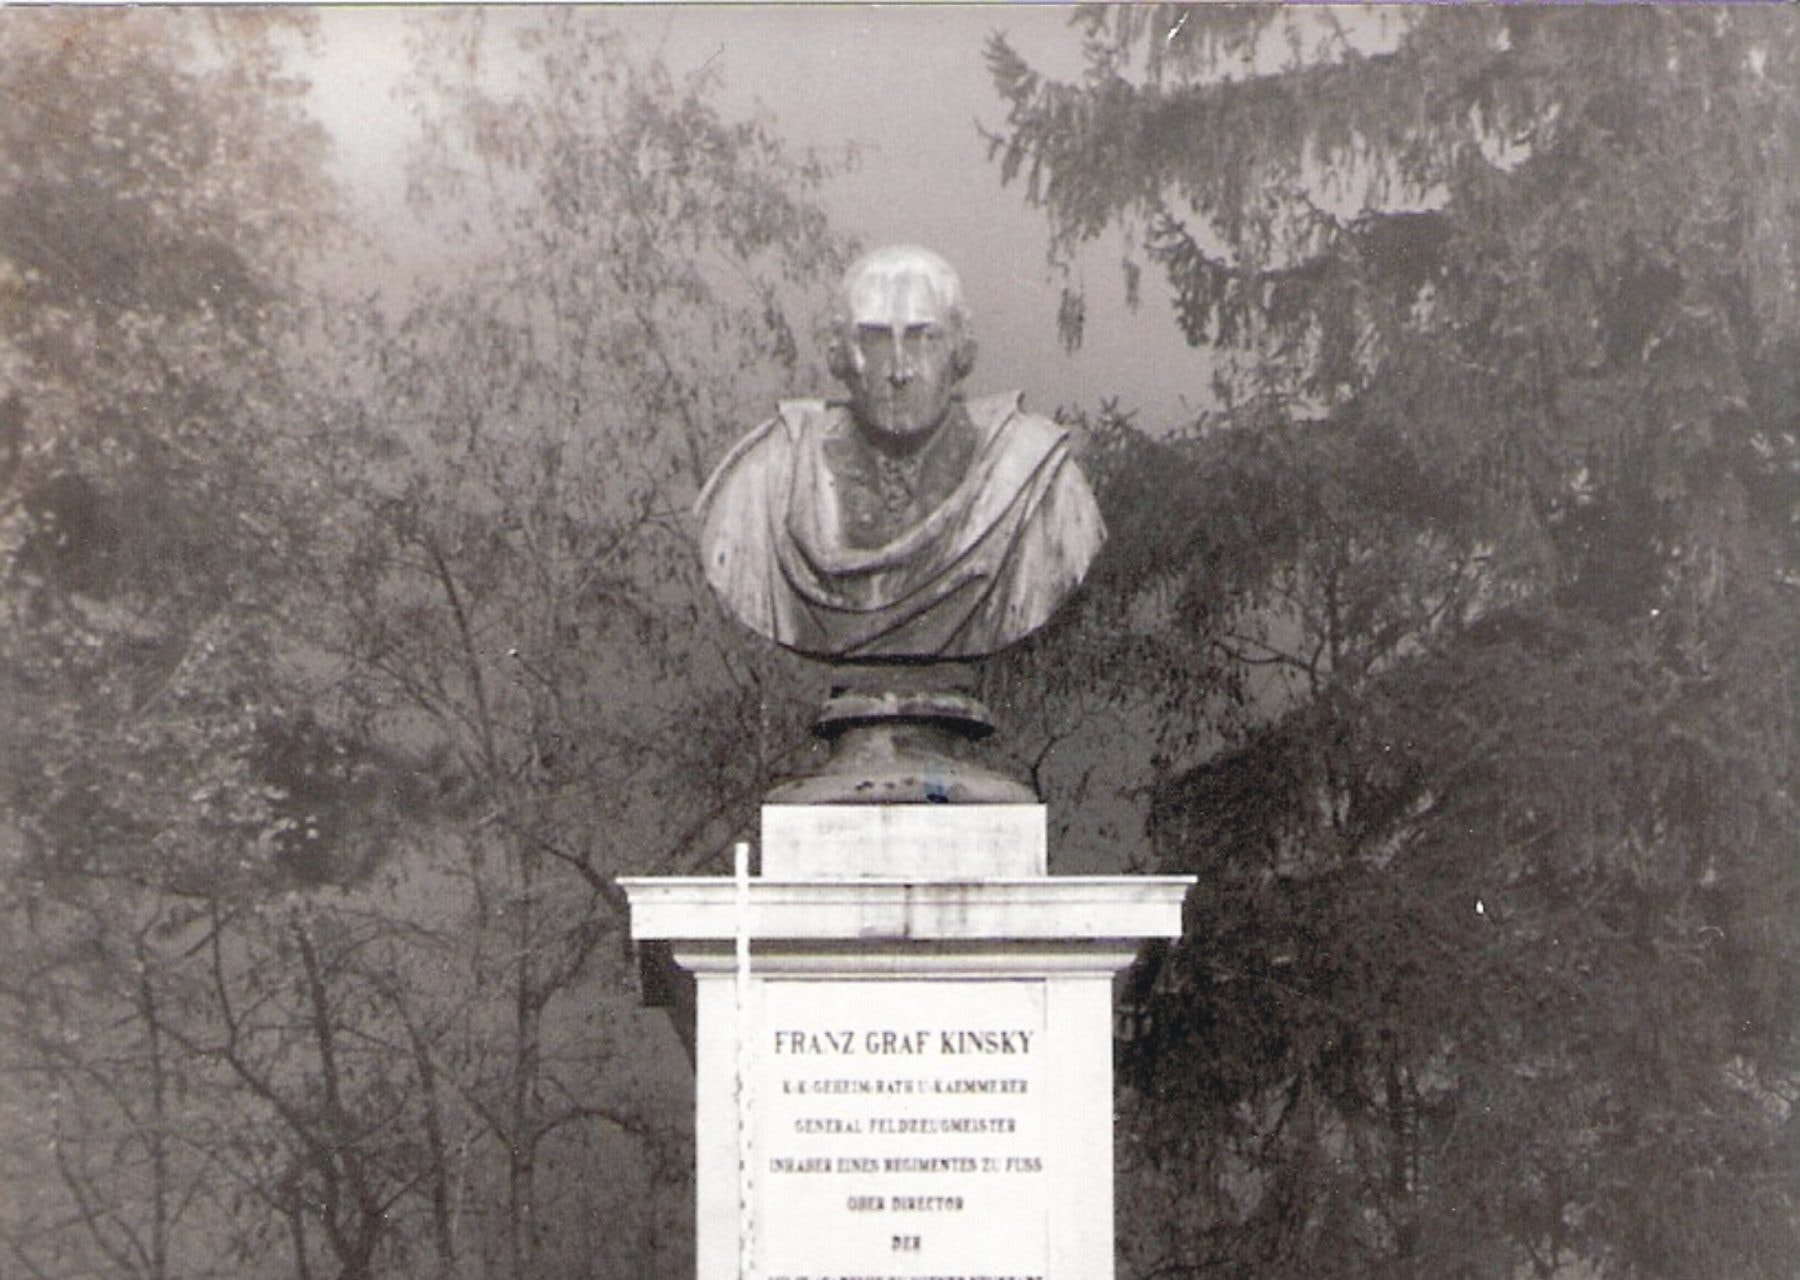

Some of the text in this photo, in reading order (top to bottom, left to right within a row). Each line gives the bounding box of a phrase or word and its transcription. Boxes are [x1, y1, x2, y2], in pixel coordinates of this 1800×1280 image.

[774, 1030, 1034, 1055] FRANZ GRAF KINSKY
[795, 1117, 1016, 1134] GENERAL FELDZEUGMEISTER
[769, 1157, 1043, 1174] INHABER EINES REGIMENTES ZU FUSS
[846, 1195, 965, 1212] OBER DIRECTOR
[891, 1235, 922, 1252] DER
